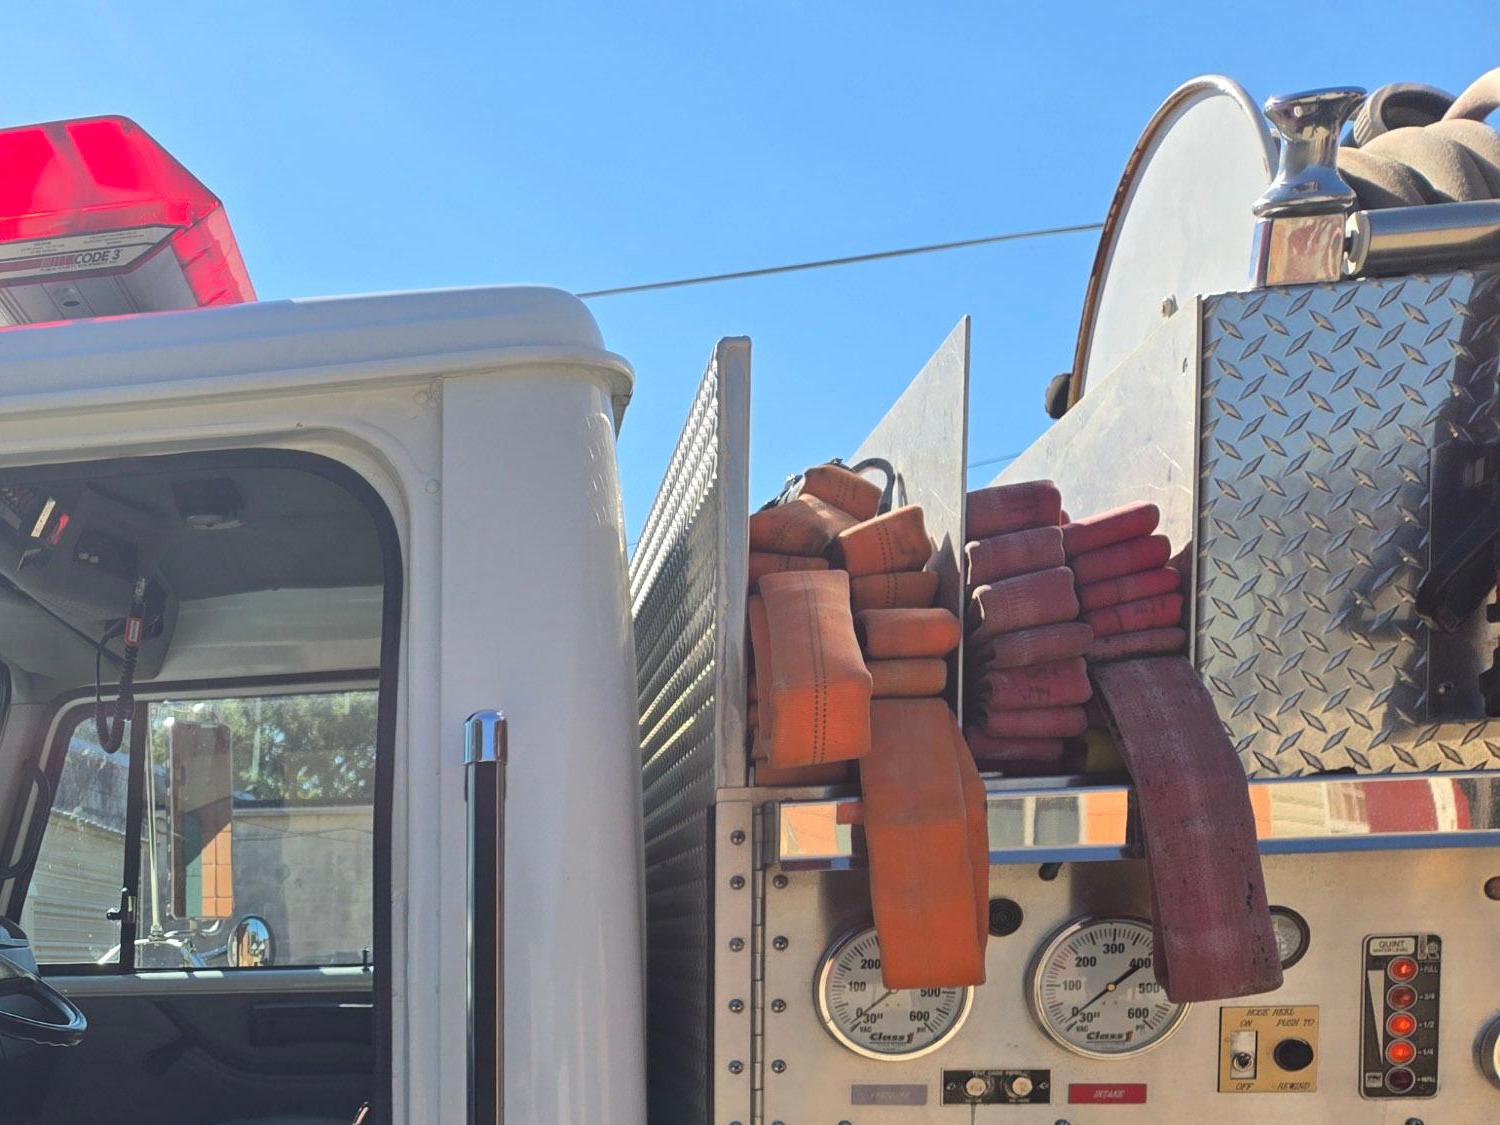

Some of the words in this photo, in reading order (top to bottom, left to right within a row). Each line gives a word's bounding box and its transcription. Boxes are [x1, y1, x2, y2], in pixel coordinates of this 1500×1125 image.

[75, 250, 111, 265] CODE
[111, 248, 121, 260] 3
[1103, 943, 1125, 954] 300
[1379, 940, 1406, 949] QUINT
[860, 959, 881, 970] 200
[1075, 956, 1097, 967] 200
[1129, 957, 1151, 969] 400
[848, 981, 867, 992] 100
[1063, 980, 1082, 991] 100
[1138, 983, 1160, 994] 500
[920, 987, 941, 998] 500
[909, 1011, 930, 1021] 600
[1128, 1008, 1149, 1019] 600
[1240, 1019, 1253, 1027] ON
[1235, 1083, 1254, 1091] OFF
[1092, 1089, 1125, 1099] INTAKE
